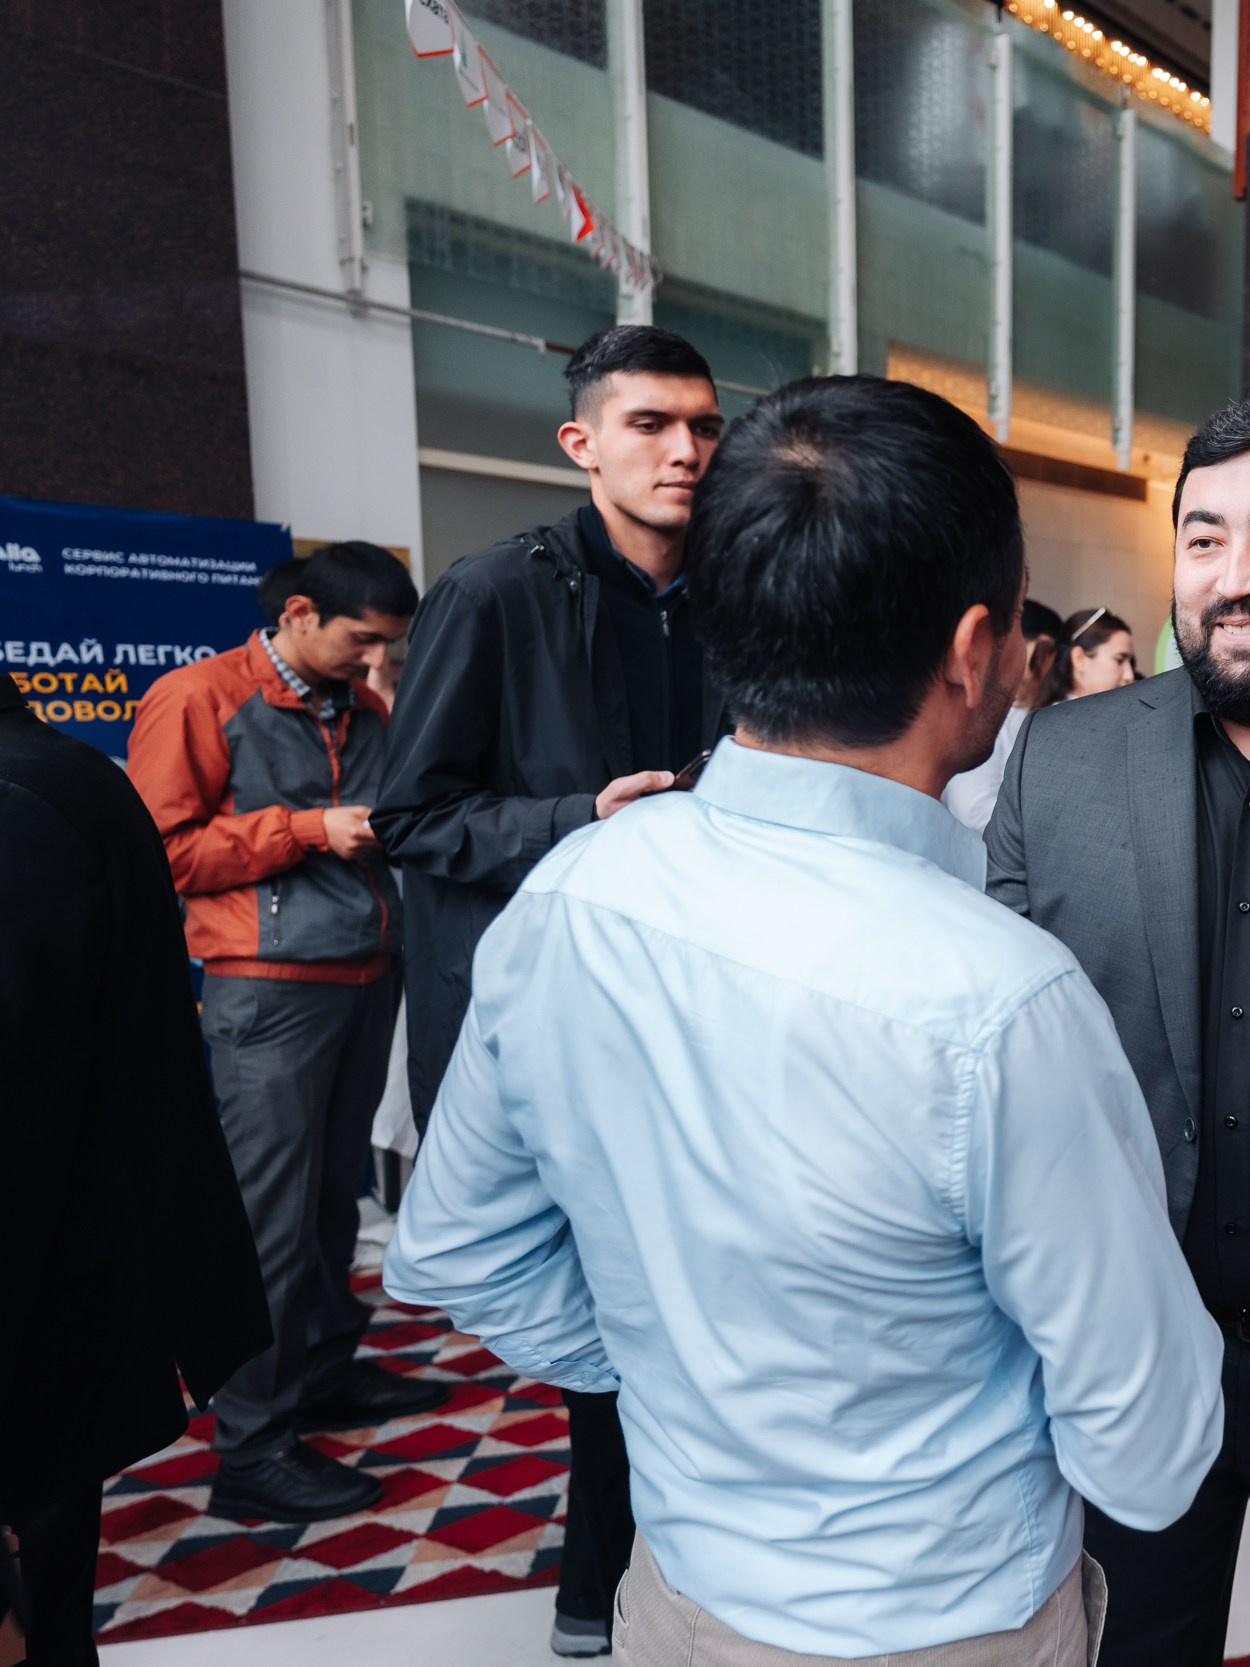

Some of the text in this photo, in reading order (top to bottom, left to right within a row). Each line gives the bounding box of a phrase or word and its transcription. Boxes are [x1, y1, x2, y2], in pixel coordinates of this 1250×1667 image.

[62, 547, 258, 573] СЕРВИС АВТОМАТИЗАЦИИ
[64, 563, 209, 584] КОРПОРАТИВНОГО
